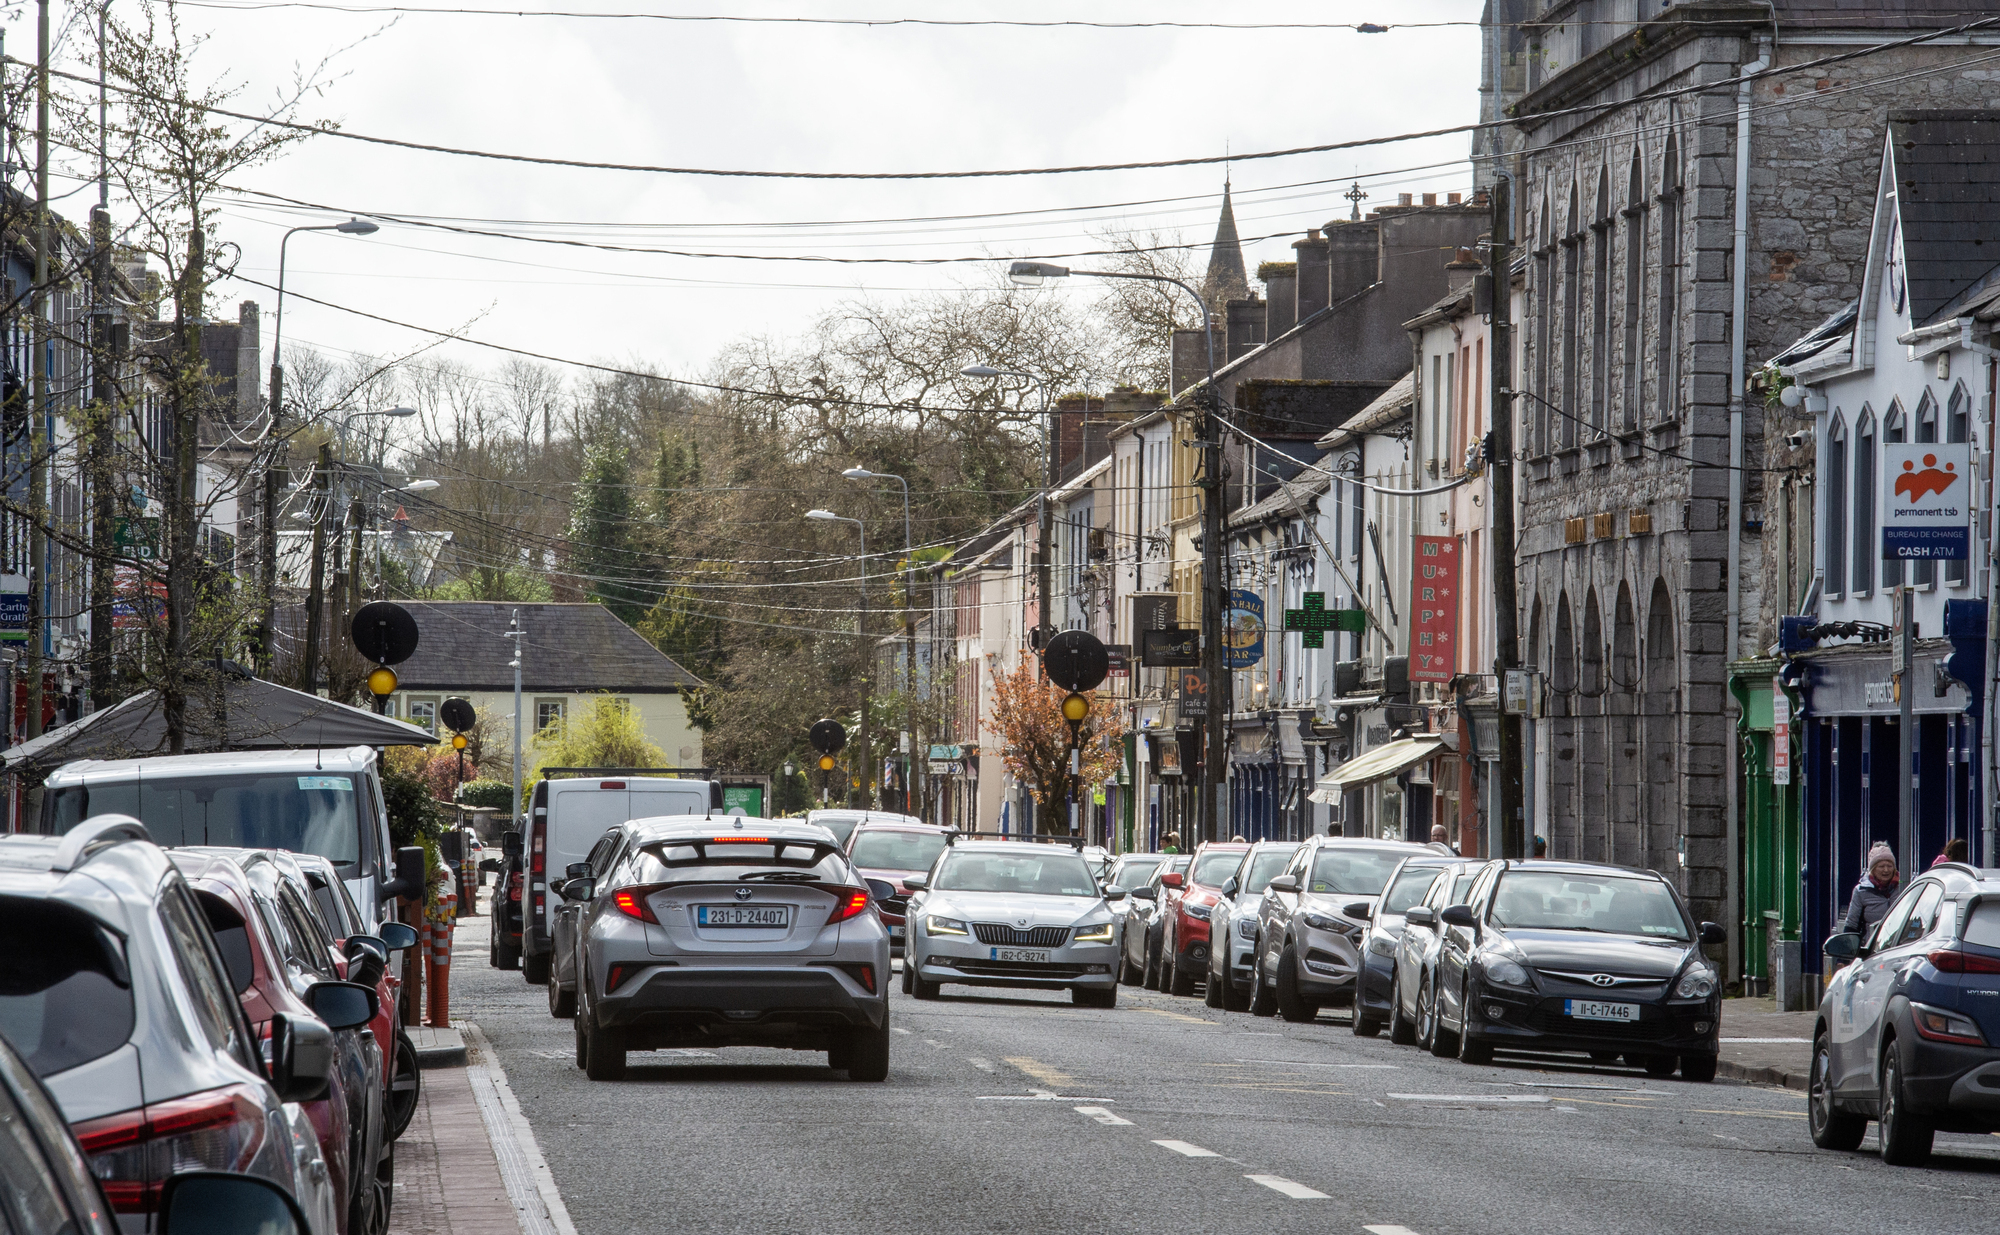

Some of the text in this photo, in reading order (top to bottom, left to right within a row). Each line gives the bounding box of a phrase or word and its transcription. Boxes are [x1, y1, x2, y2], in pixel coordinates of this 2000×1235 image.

[1895, 507, 1958, 518] permanent tsb
[1888, 530, 1964, 538] BUREAU DE CHANGE
[1898, 546, 1955, 557] CASH ATM
[1239, 600, 1261, 613] HALL
[1418, 542, 1438, 668] MURPHY
[1109, 669, 1126, 677] LET
[1185, 699, 1201, 707] café
[711, 910, 783, 924] 231-D-24407
[1001, 951, 1046, 962] 162-C-9274
[1581, 1003, 1630, 1018] 11-C-17446
